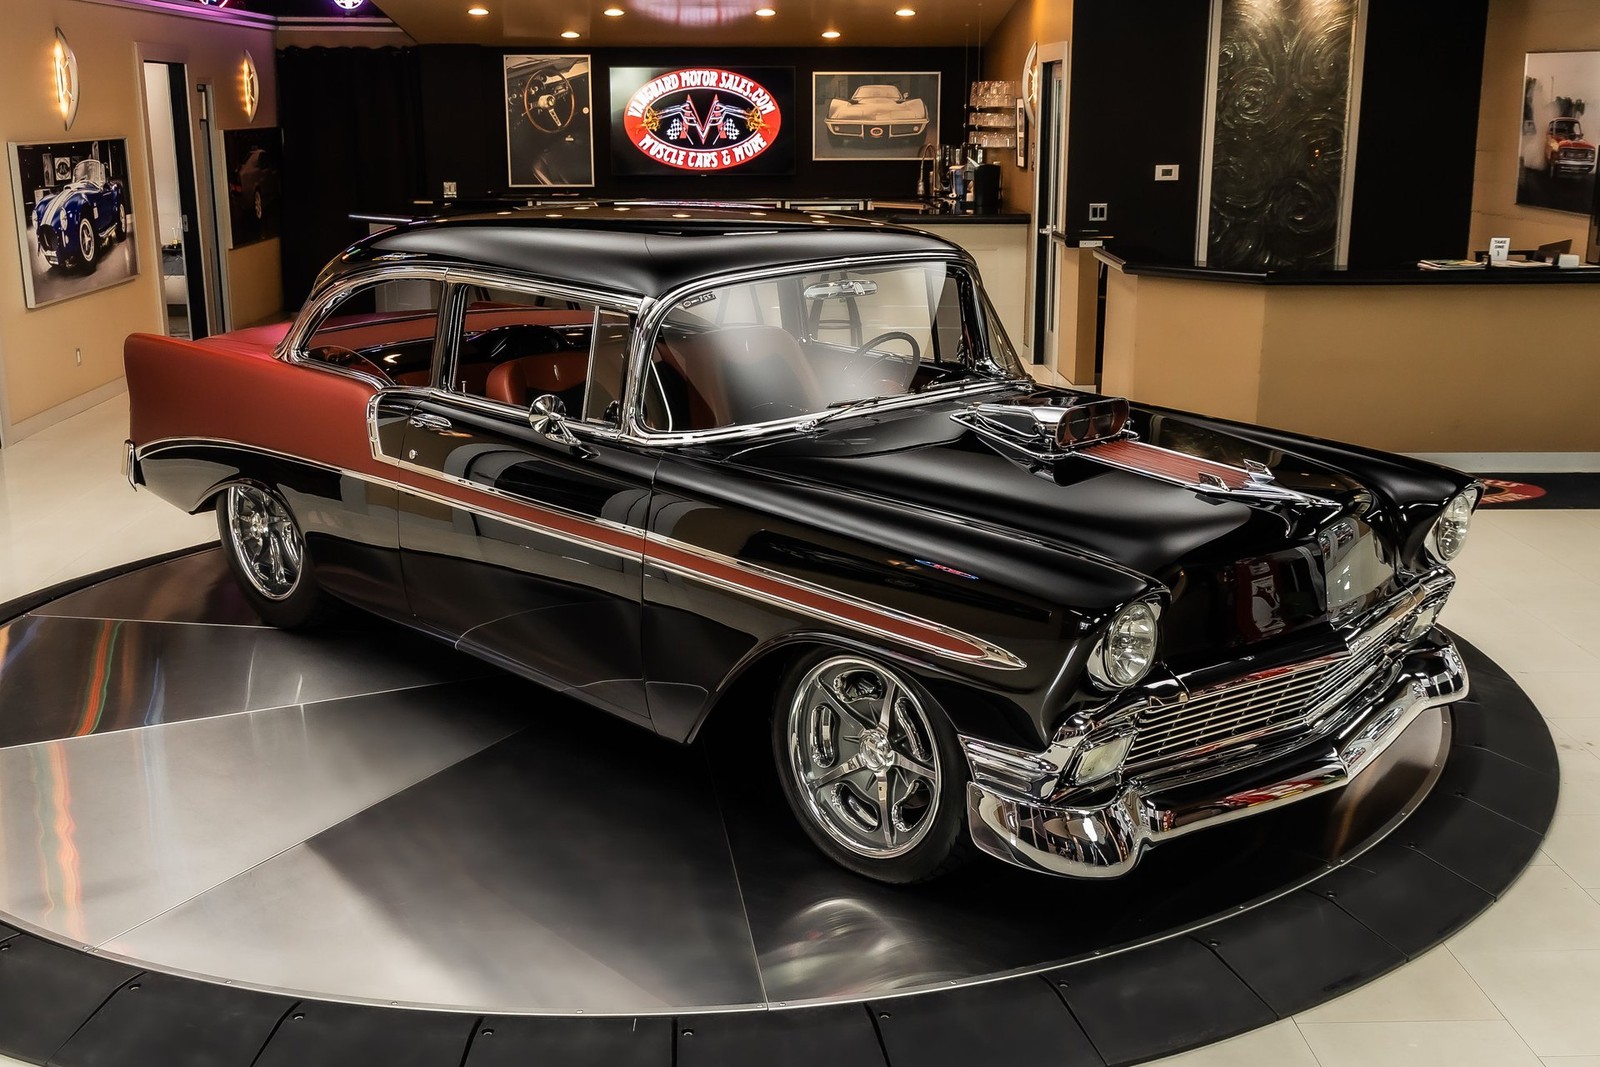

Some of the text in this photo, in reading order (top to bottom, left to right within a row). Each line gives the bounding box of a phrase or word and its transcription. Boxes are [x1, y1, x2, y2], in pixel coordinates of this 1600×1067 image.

[627, 70, 776, 118] VANGUARD MOTOR SALES.COM
[638, 132, 768, 168] MUSCLE CARS & MORE
